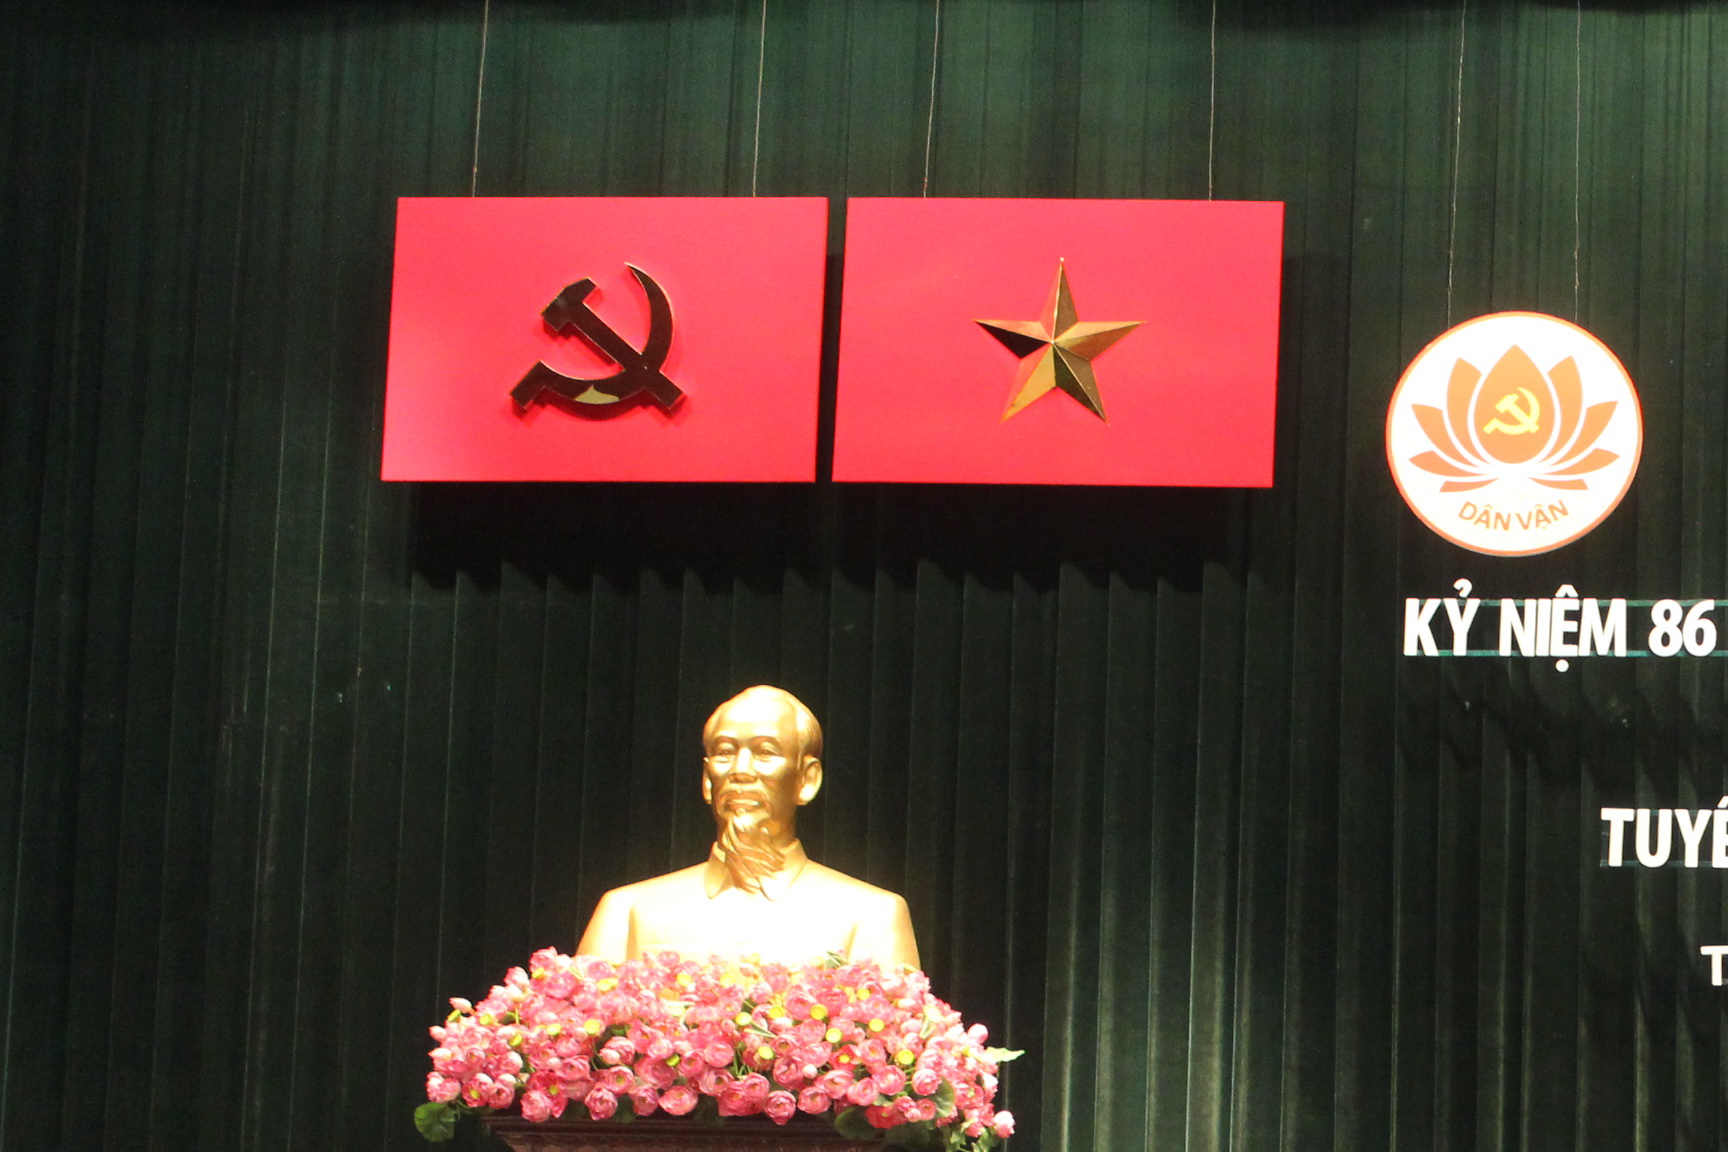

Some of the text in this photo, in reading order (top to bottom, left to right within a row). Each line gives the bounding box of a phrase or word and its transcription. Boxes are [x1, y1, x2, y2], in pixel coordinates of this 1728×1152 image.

[1458, 499, 1569, 531] DÂN VẬN
[1403, 578, 1481, 657] KỶ
[1498, 584, 1627, 673] NIỆM
[1648, 599, 1717, 657] 86
